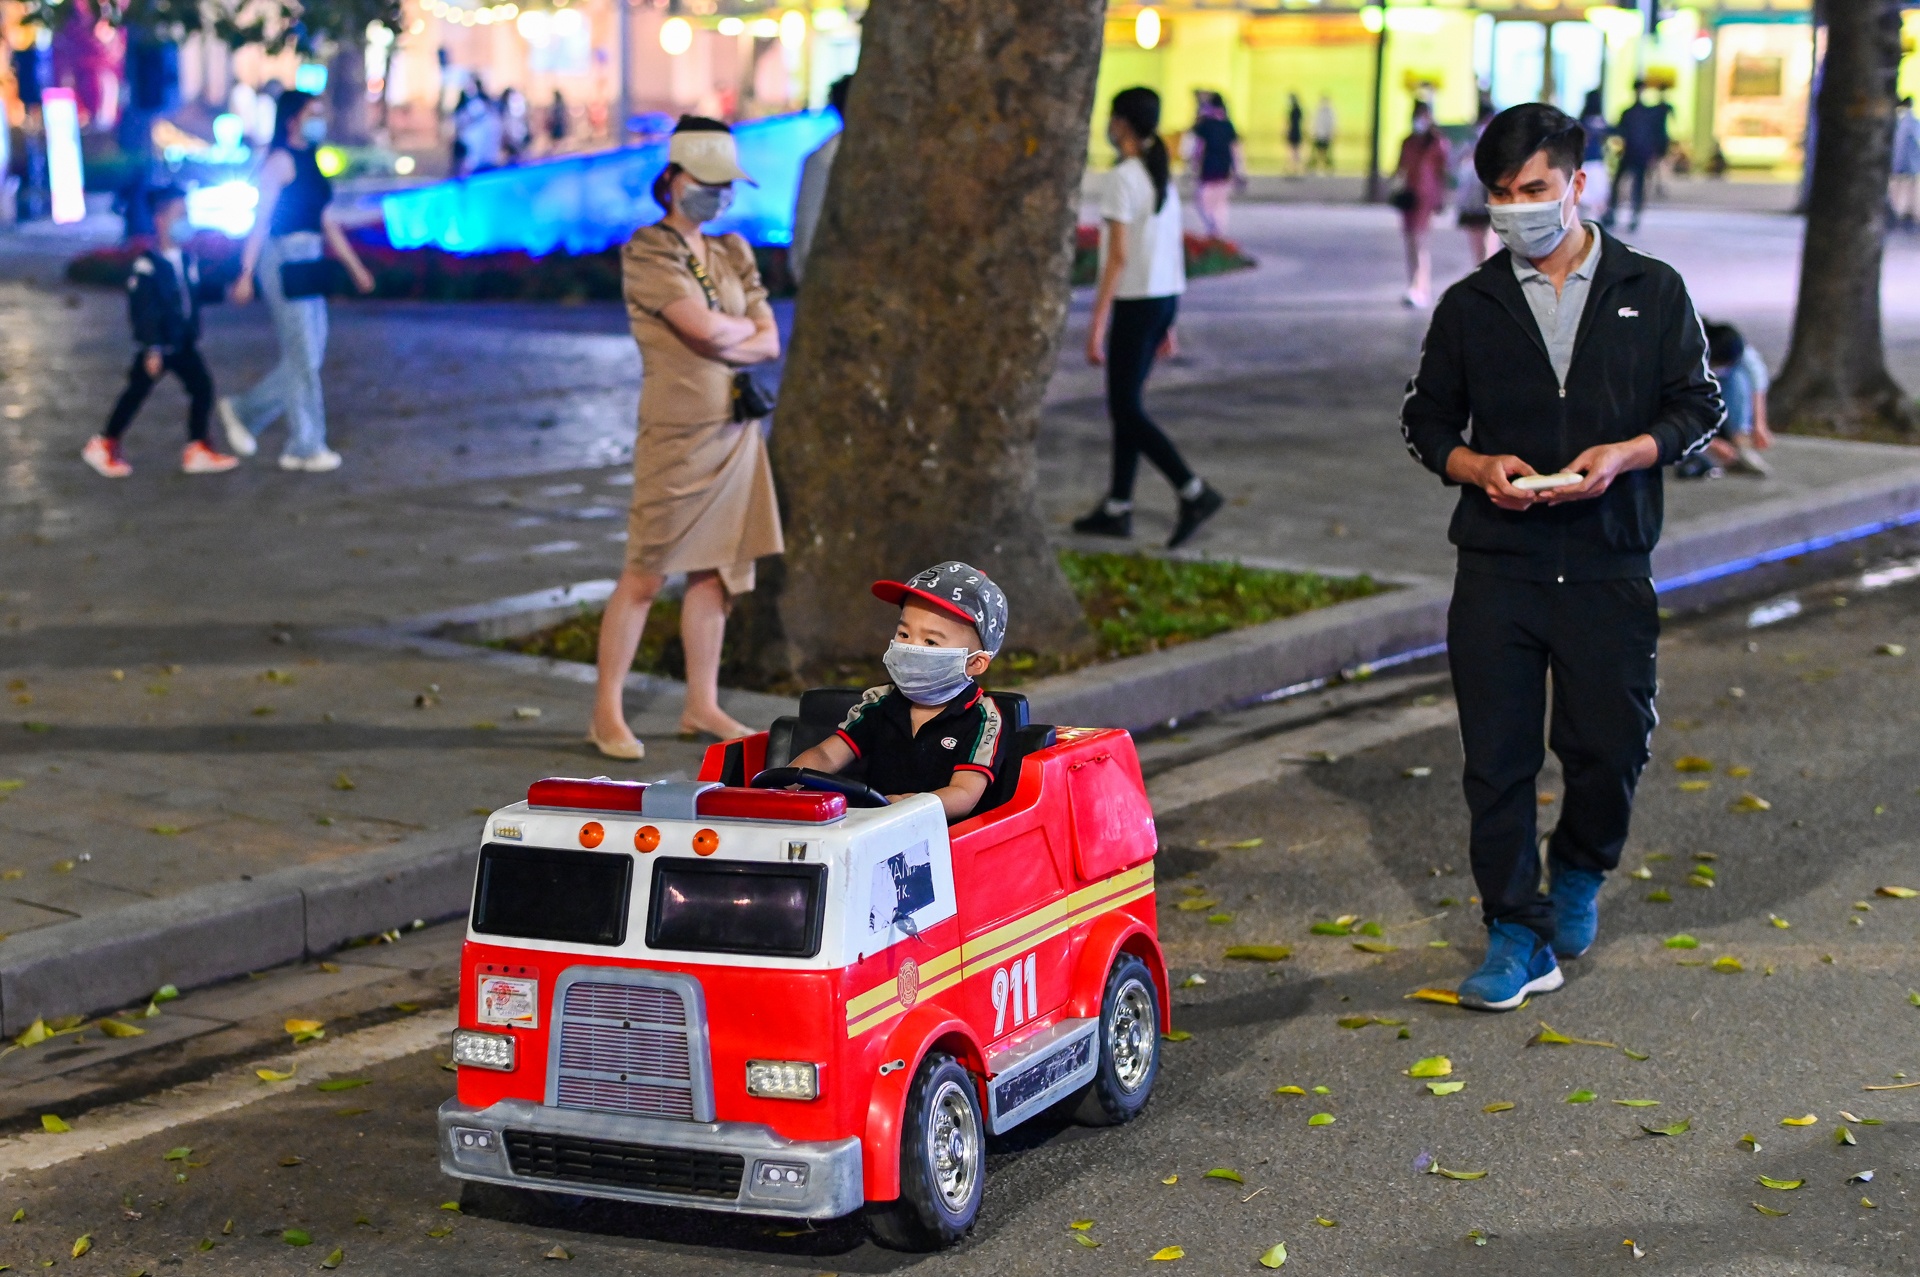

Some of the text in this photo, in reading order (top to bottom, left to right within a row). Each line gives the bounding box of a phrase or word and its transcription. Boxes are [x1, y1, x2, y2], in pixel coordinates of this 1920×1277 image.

[966, 576, 979, 585] 2
[951, 587, 963, 601] 5
[983, 590, 991, 603] 3
[996, 593, 1003, 608] 2
[989, 617, 997, 633] 2
[984, 711, 998, 745] GUCCI
[991, 952, 1038, 1038] 911
